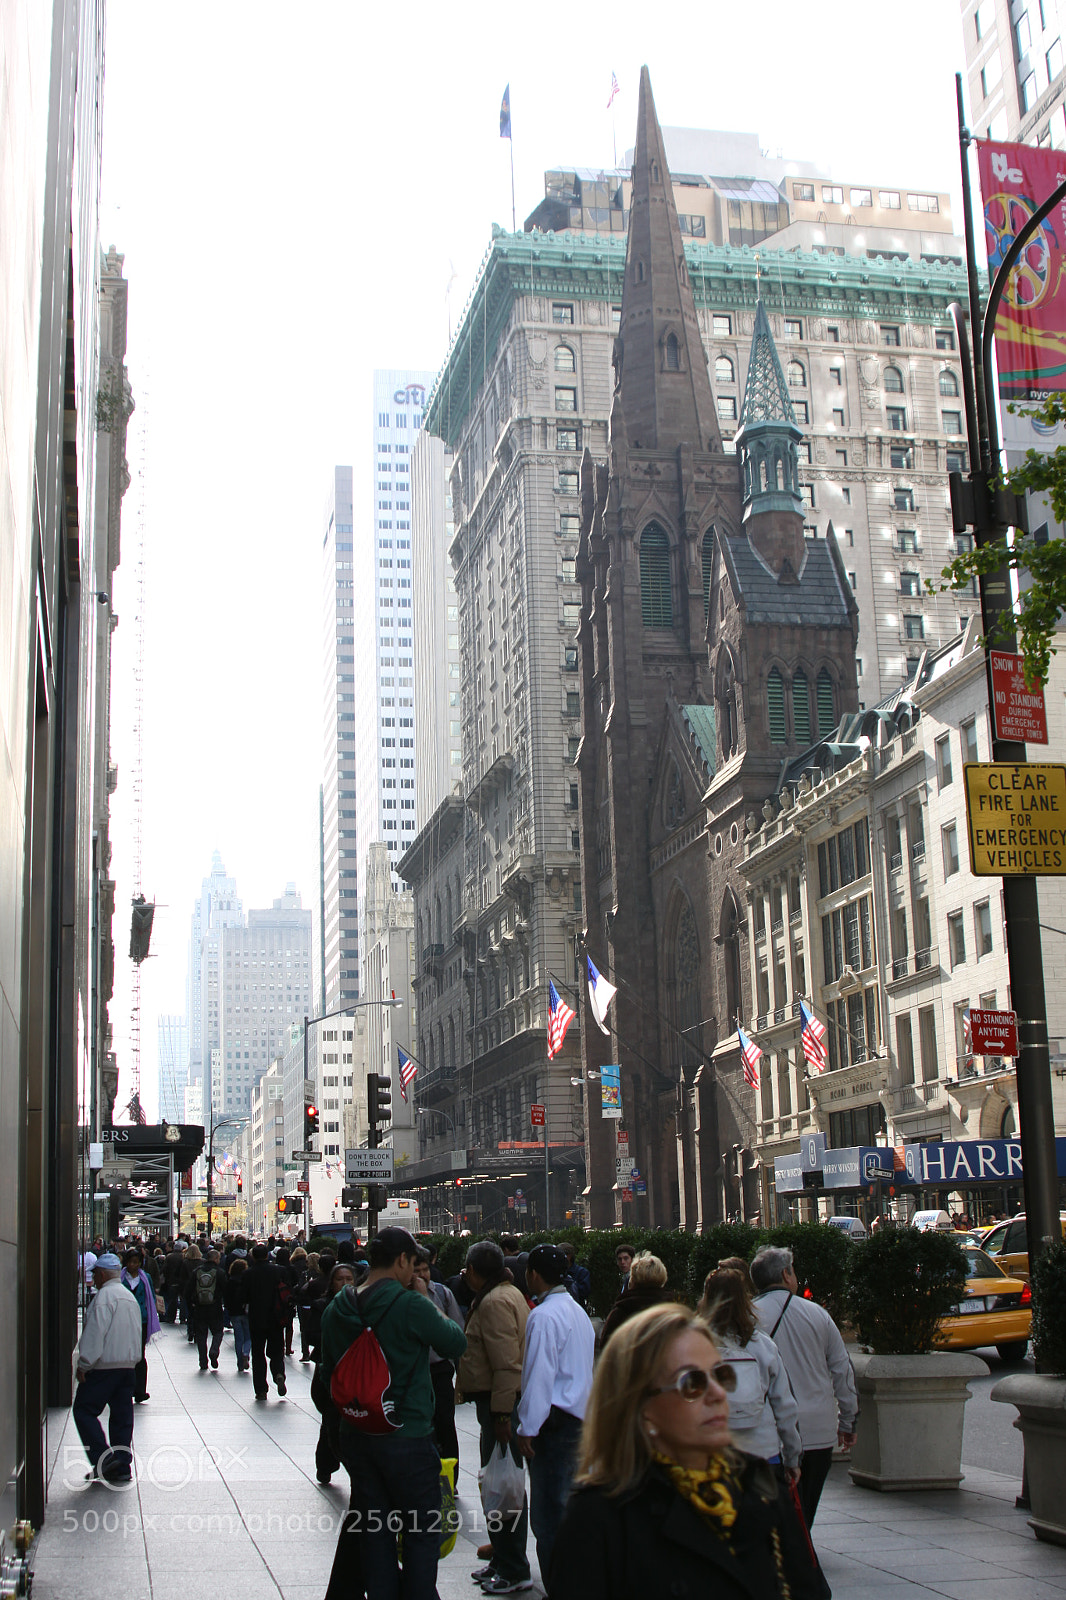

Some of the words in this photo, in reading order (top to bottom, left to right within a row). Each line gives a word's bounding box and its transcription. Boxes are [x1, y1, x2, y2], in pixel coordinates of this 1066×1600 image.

[991, 152, 1023, 184] NYC
[393, 384, 425, 405] citi
[993, 657, 1013, 672] SNOW
[995, 691, 1006, 704] NO
[1010, 692, 1043, 709] STANDING
[1008, 706, 1032, 718] DURING
[1002, 716, 1040, 729] EMERGENCY
[1002, 726, 1024, 737] VEHICLES
[1026, 729, 1043, 739] TOWED
[988, 773, 1047, 790] CLEAR
[979, 795, 1014, 811] FIRE
[1021, 795, 1059, 811] LANE
[1010, 814, 1032, 826] FOR
[976, 829, 1066, 846] EMERGENCY
[987, 850, 1062, 867] VEHICLES
[972, 1013, 981, 1024] NO
[983, 1014, 1014, 1025] STANDING
[978, 1027, 1010, 1038] ANYTIME
[838, 1162, 859, 1173] WINSTON
[921, 1143, 1023, 1181] HARR
